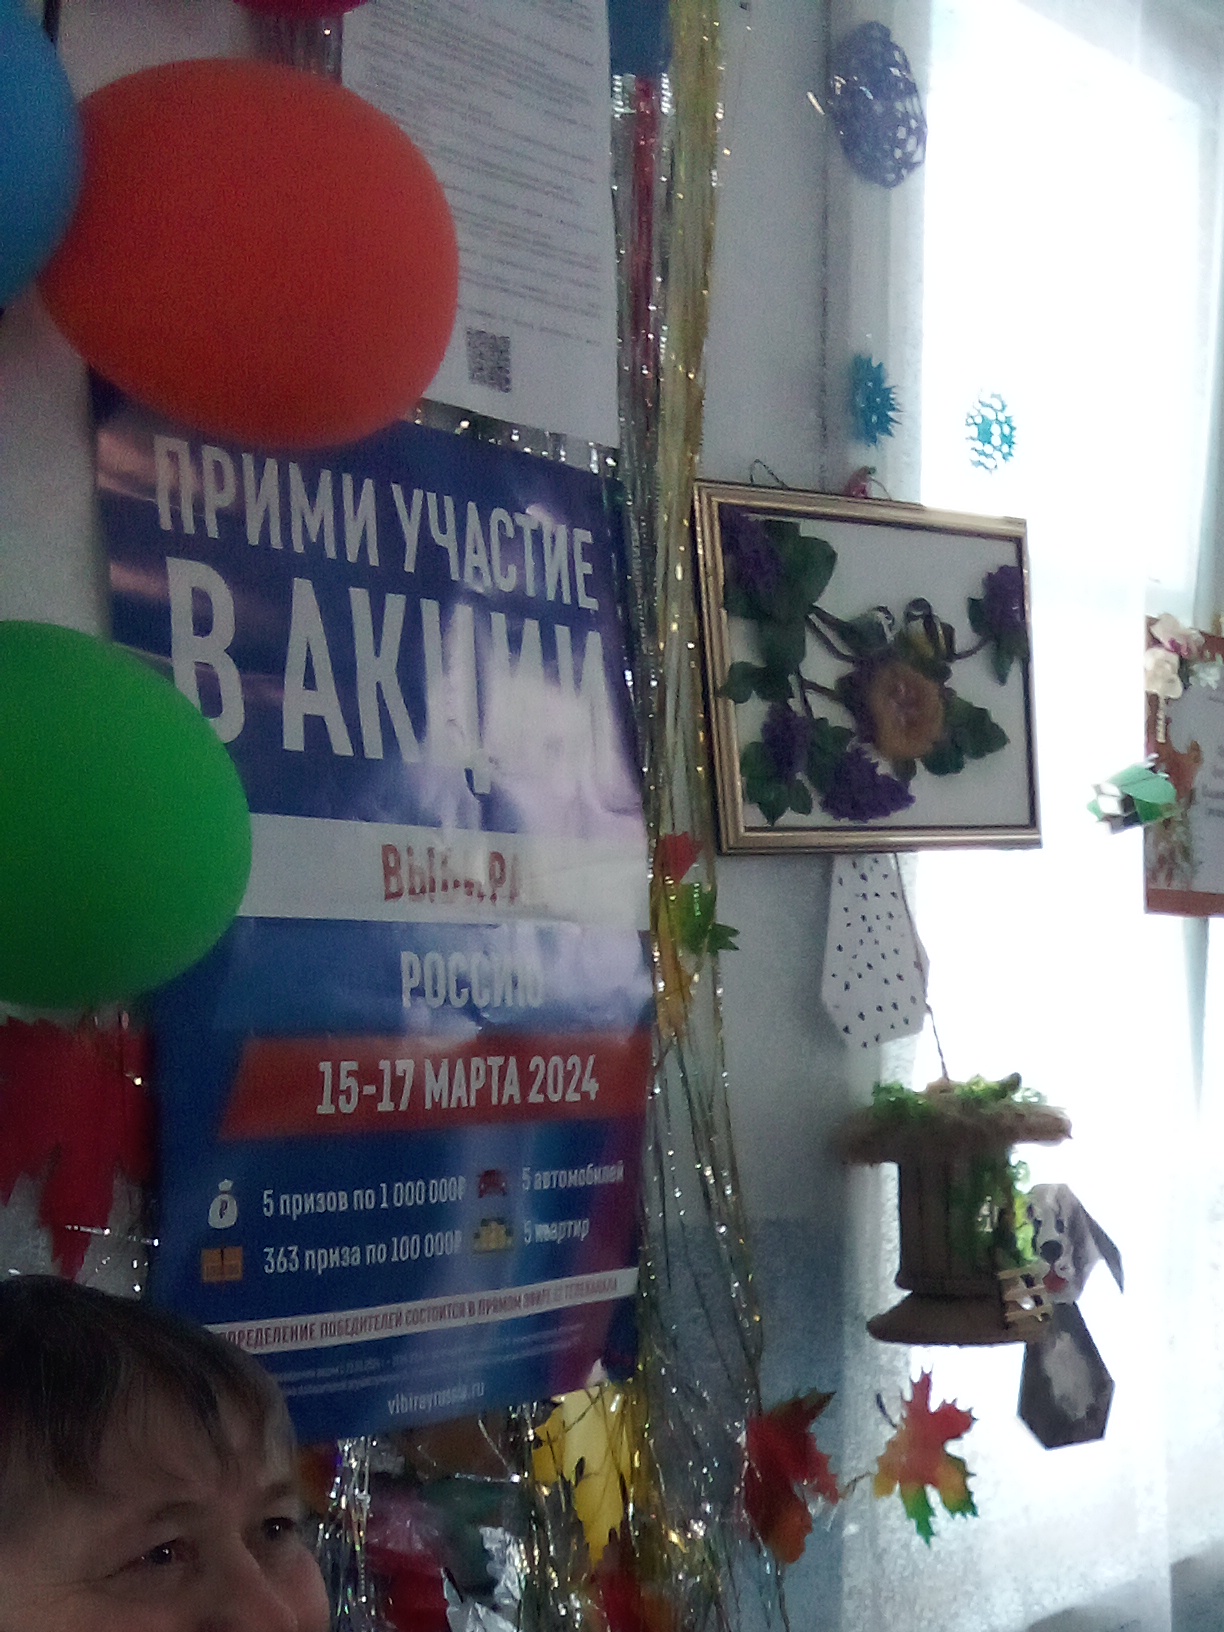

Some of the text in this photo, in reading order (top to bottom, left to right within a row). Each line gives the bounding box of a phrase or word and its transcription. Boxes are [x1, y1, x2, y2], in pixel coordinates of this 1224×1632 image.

[153, 434, 599, 611] ПРИМИ УЧАСТИЕ
[166, 556, 246, 744] В
[316, 1053, 600, 1115] 15-17 МАРТА 2024
[263, 1189, 275, 1218] 5
[279, 1191, 349, 1221] призов
[353, 1189, 376, 1211] по
[379, 1182, 389, 1209] 1
[393, 1179, 426, 1207] 000
[522, 1166, 531, 1191] 5
[263, 1245, 300, 1275] 363
[303, 1245, 361, 1276] приза
[365, 1243, 388, 1266] по
[391, 1234, 420, 1262] 100
